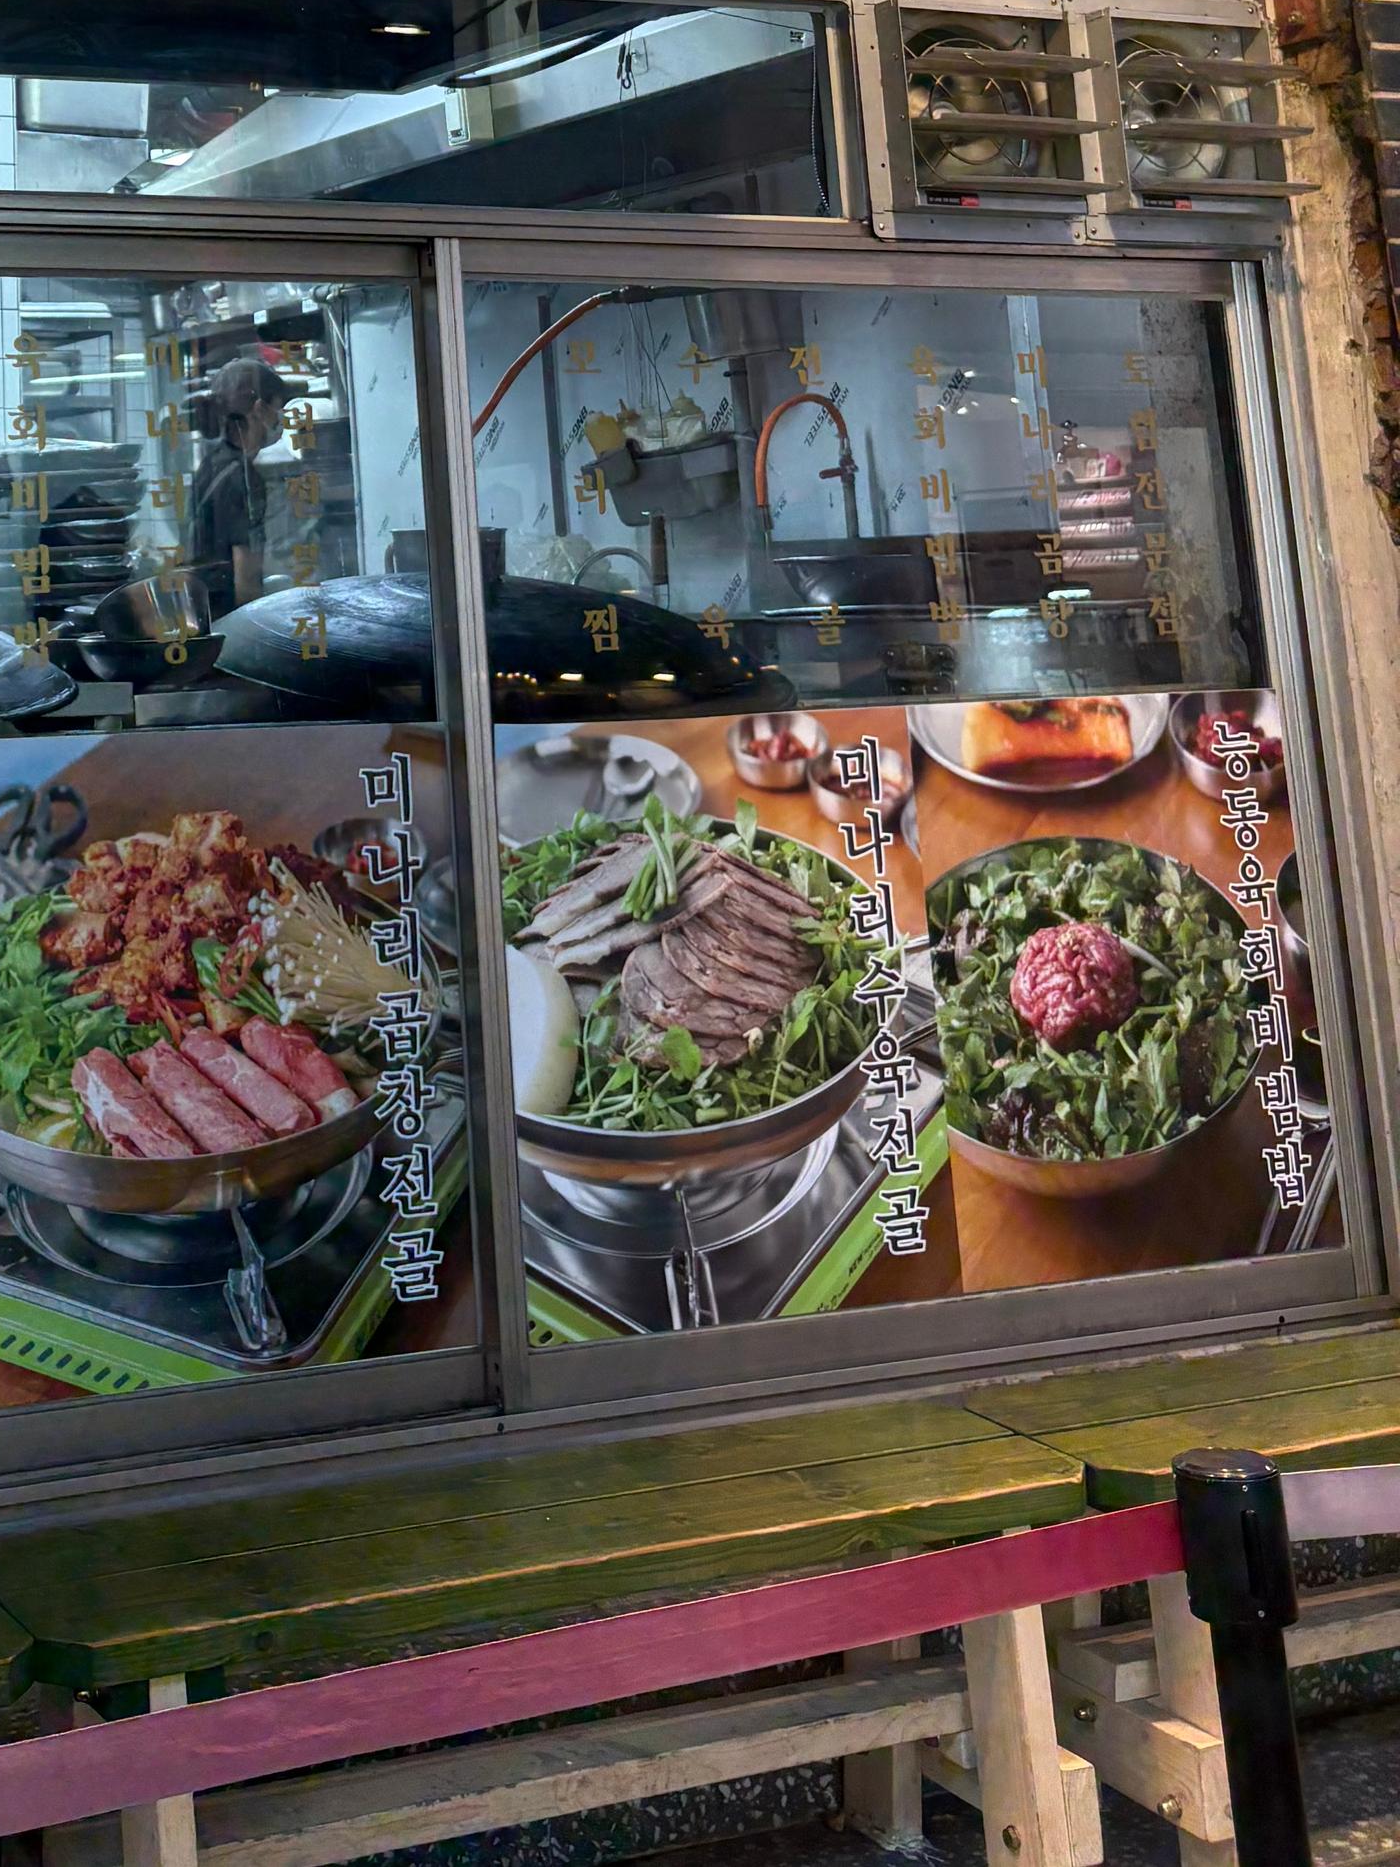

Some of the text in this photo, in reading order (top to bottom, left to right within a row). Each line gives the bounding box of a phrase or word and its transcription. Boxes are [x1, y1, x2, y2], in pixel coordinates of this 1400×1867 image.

[358, 750, 445, 1302] 미나리곱창전골
[833, 735, 929, 1255] 미나리수육전골
[1210, 720, 1311, 1208] 능동육회비빔밥
